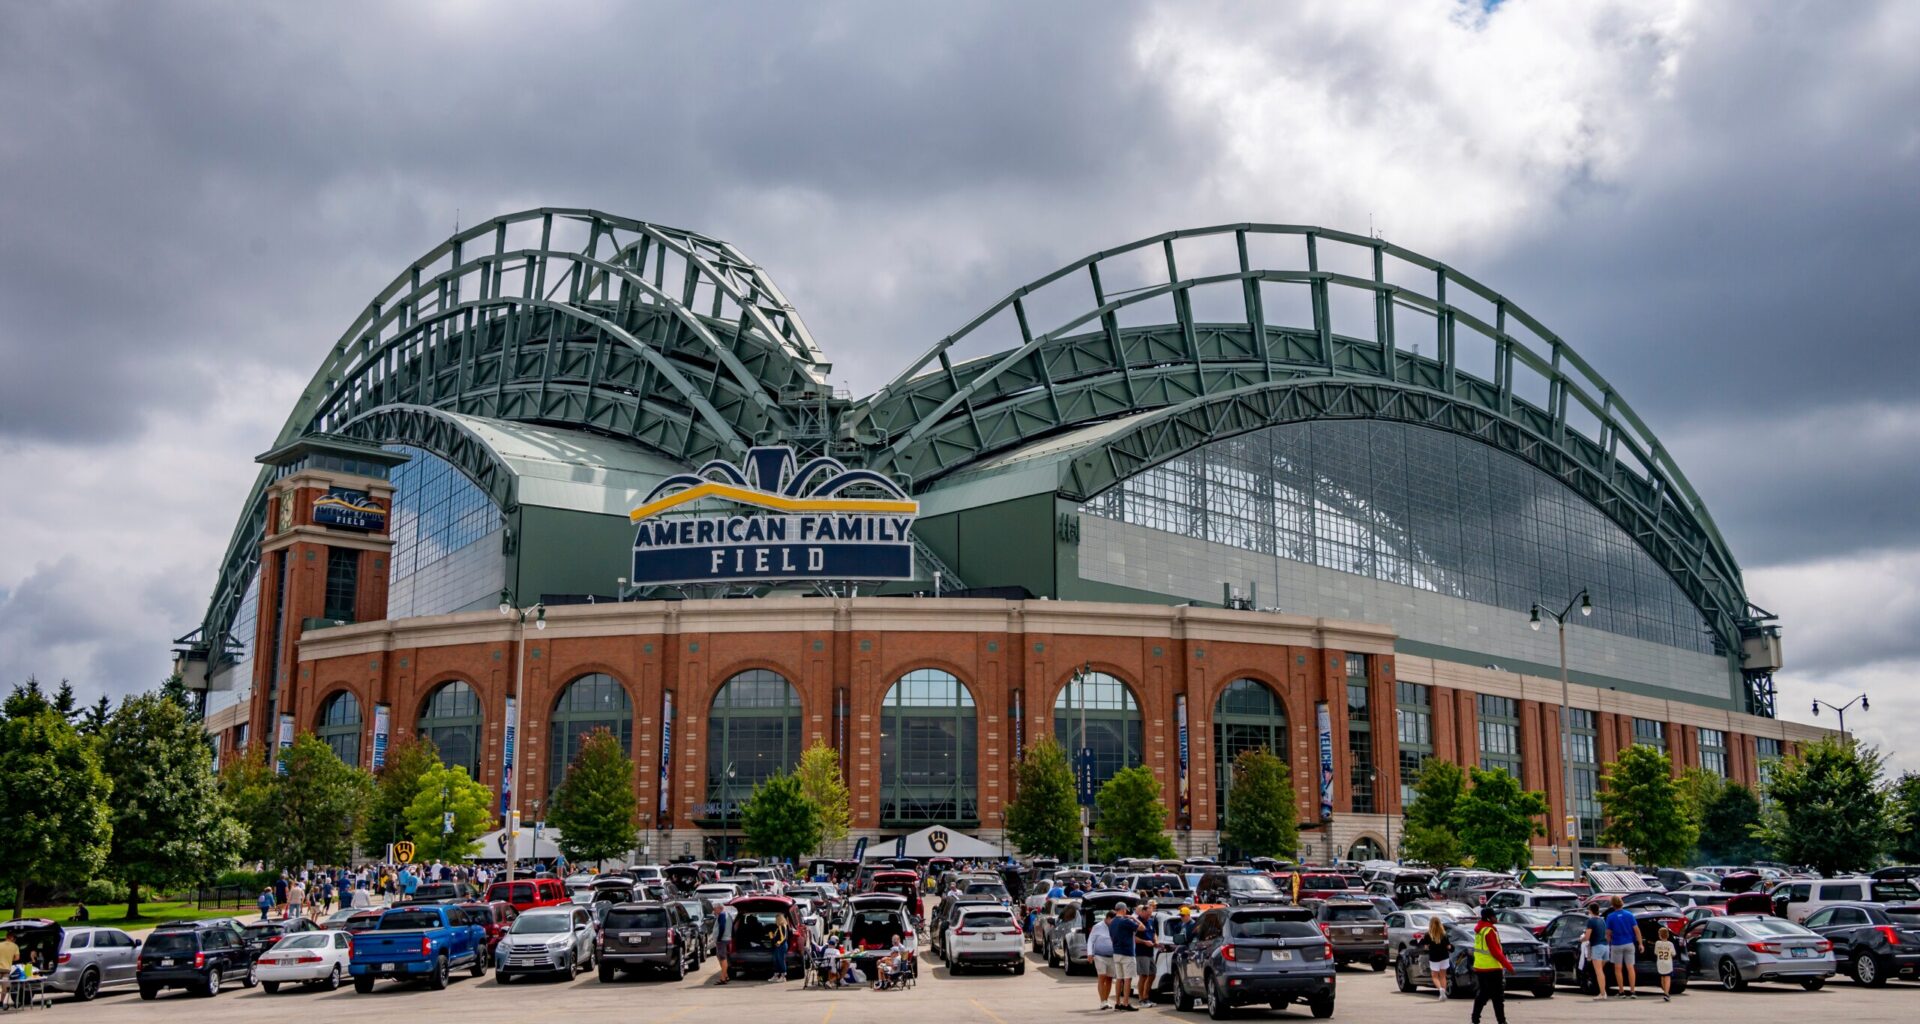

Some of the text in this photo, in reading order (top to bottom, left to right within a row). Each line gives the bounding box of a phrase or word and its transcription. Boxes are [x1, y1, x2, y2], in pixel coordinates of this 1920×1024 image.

[336, 516, 365, 526] FIELD
[635, 517, 911, 547] AMERICAN FAMILY
[711, 548, 824, 573] FIELD
[1658, 951, 1669, 960] 22
